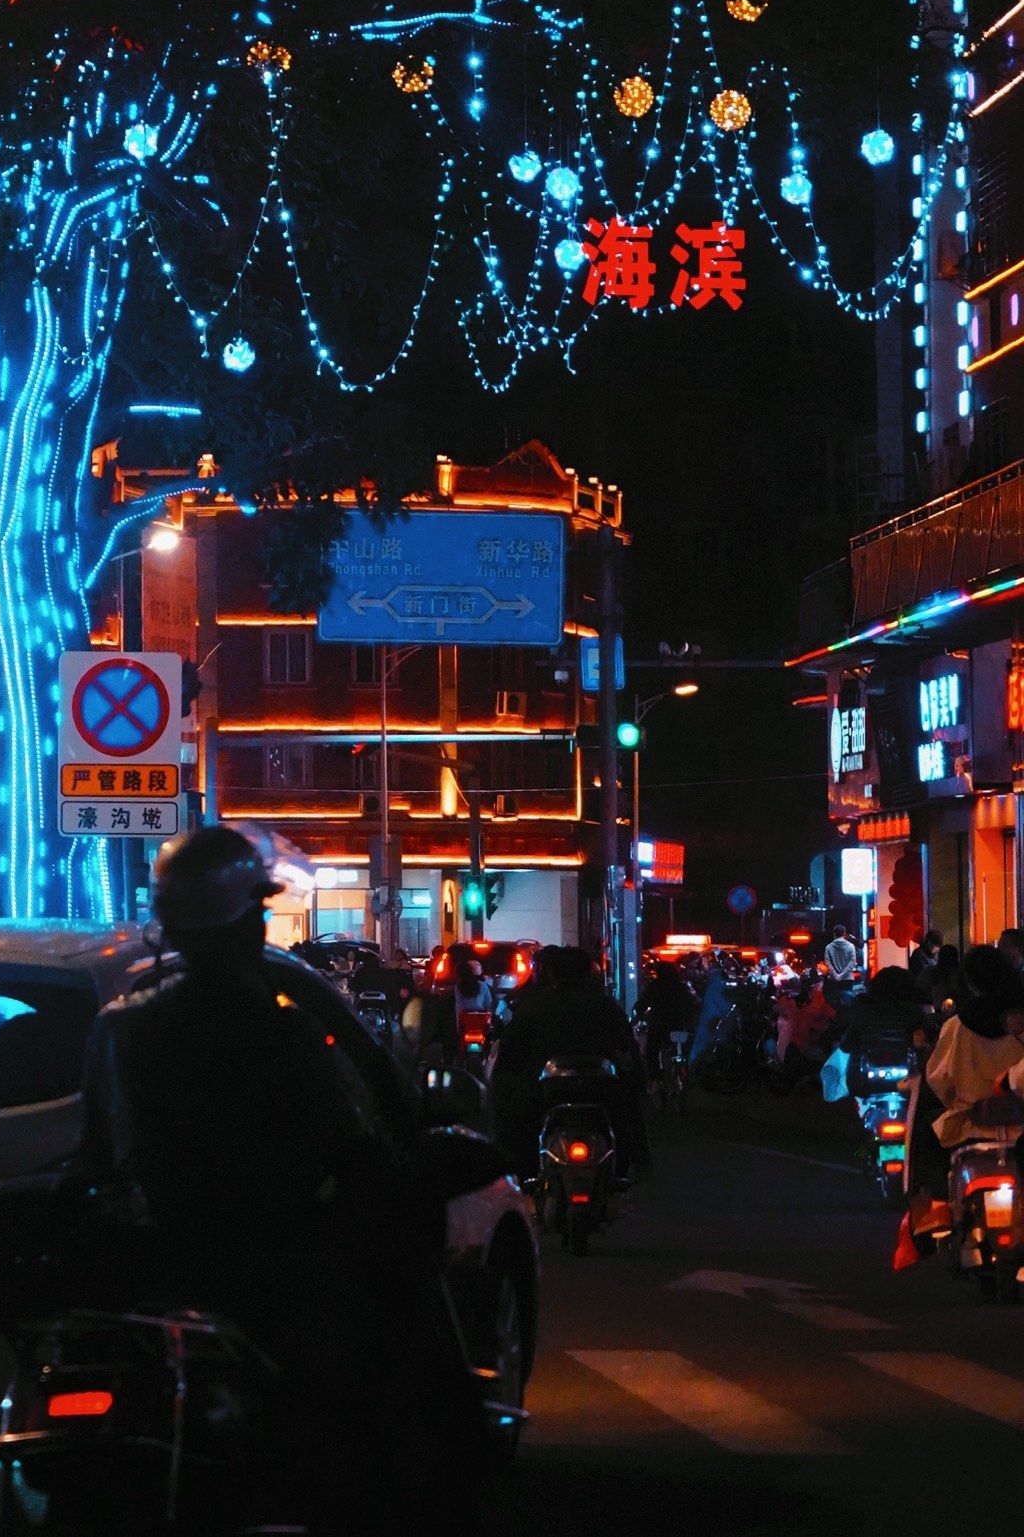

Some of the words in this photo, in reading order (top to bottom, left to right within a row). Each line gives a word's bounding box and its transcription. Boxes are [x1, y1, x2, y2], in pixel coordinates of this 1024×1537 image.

[581, 217, 747, 312] 海滨
[478, 538, 555, 563] 新华路
[328, 563, 398, 577] hongshan
[403, 595, 478, 615] 新门街
[72, 769, 167, 791] 严管路段
